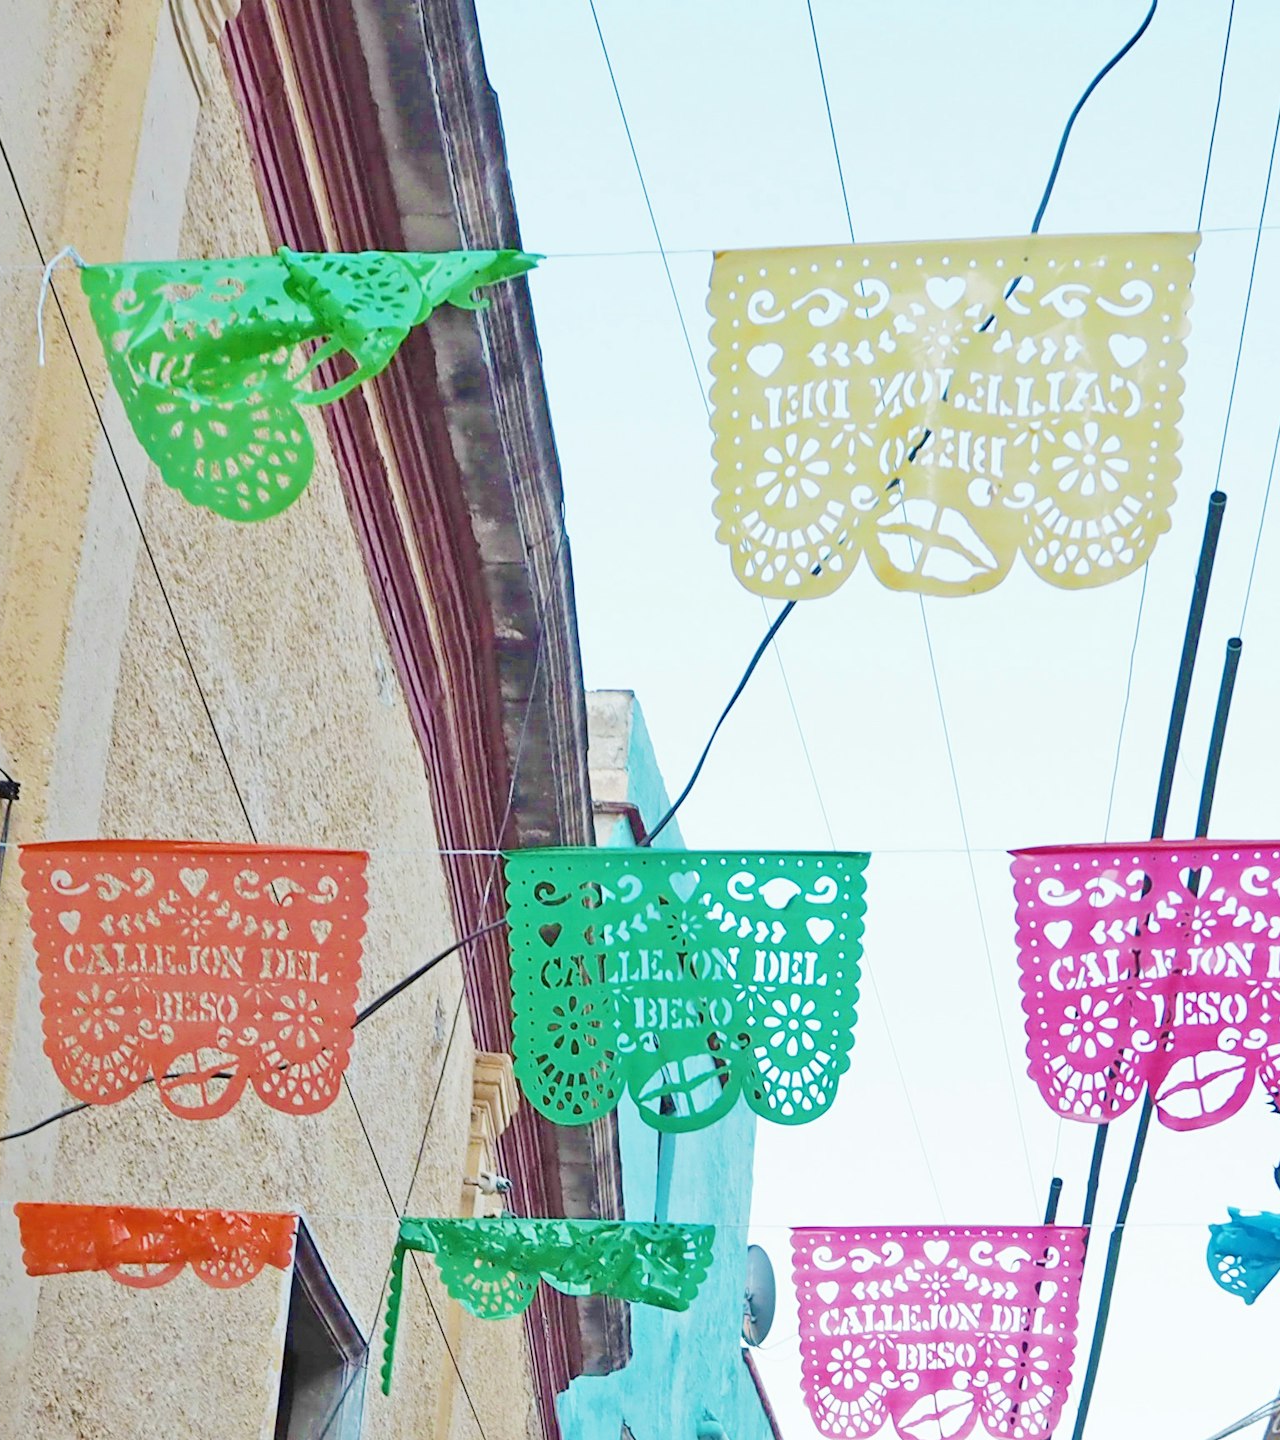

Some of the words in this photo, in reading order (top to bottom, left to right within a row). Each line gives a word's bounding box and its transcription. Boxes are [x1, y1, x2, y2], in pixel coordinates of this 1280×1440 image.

[63, 942, 244, 978] CALLEJON
[259, 948, 329, 985] DEL
[540, 946, 741, 990] CALLEJON
[752, 949, 829, 987] DEL
[1048, 941, 1256, 992] CALLEJON
[154, 990, 239, 1024] BESO
[634, 996, 734, 1030] BESO
[820, 1303, 983, 1336] CALLEJON
[990, 1304, 1054, 1334] DEL
[896, 1342, 976, 1370] BESO
